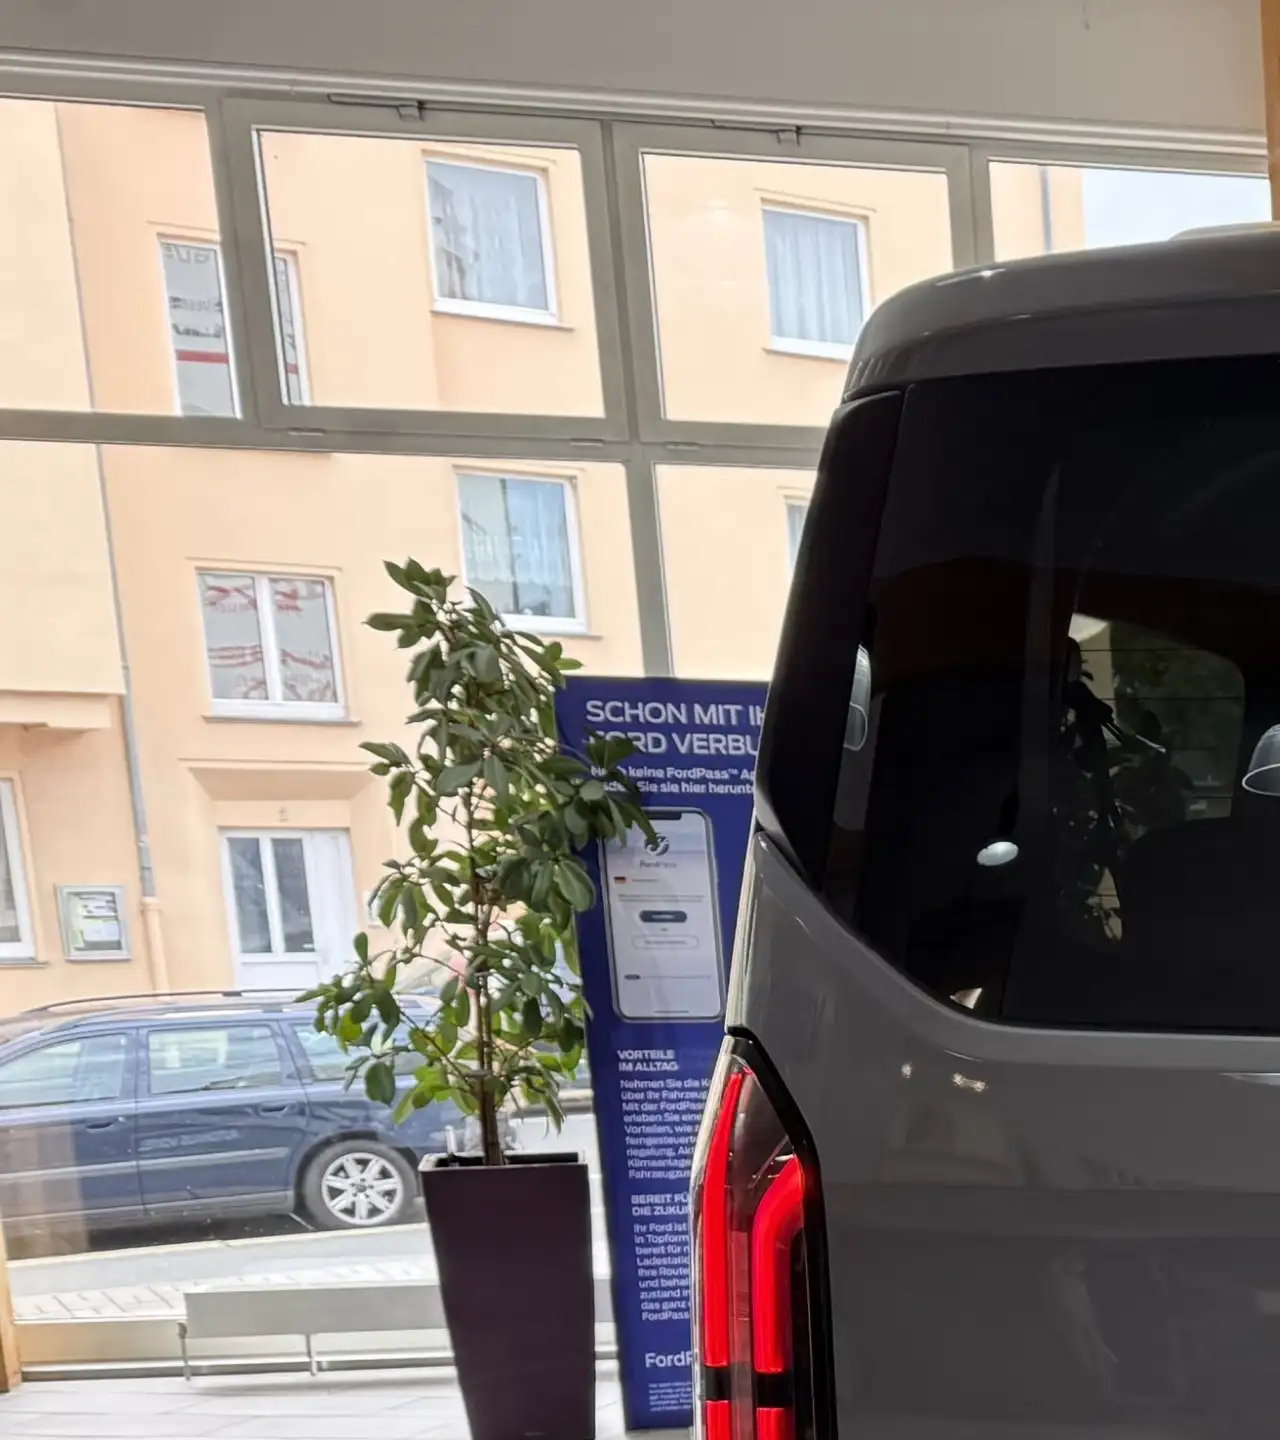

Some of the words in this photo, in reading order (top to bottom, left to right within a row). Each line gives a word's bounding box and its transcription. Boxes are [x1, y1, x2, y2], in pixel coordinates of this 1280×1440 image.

[586, 700, 688, 724] SCHON
[693, 703, 743, 726] MIT
[628, 766, 664, 778] keine
[637, 781, 658, 793] Sie
[660, 781, 679, 793] sie
[681, 782, 706, 793] hier
[617, 1049, 675, 1060] VORTEILE
[619, 1062, 633, 1071] IM
[635, 1061, 679, 1071] ALLTAG
[631, 1194, 672, 1204] BEREIT
[632, 1206, 651, 1216] DIE
